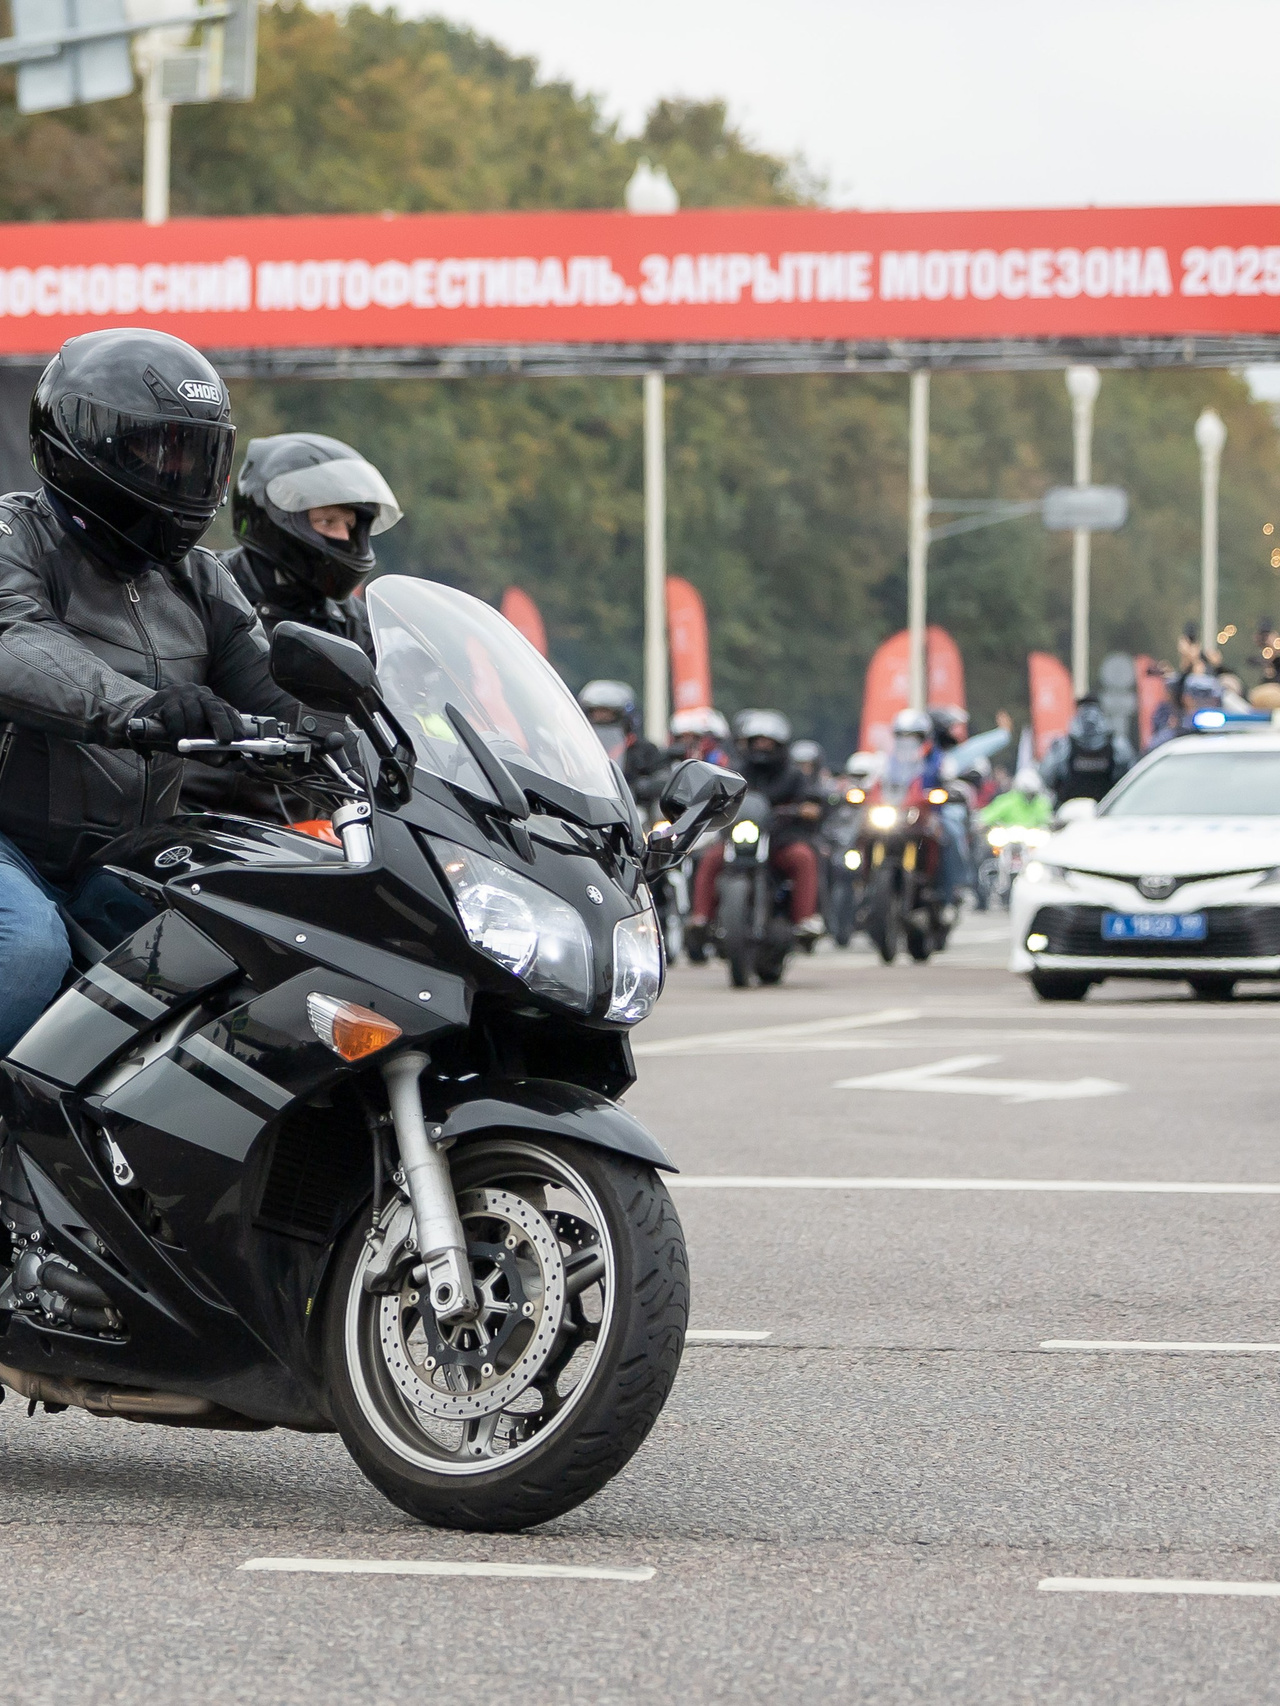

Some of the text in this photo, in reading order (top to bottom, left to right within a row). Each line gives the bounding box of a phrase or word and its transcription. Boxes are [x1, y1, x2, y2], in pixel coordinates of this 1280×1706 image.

[256, 251, 636, 311] МОТОФЕСТИВАЛЬ.
[639, 251, 874, 304] ЗАКРЫТИЕ
[879, 247, 1173, 301] МОТОСЕЗОНА
[1180, 245, 1280, 297] 2025
[184, 383, 220, 402] SHOEI
